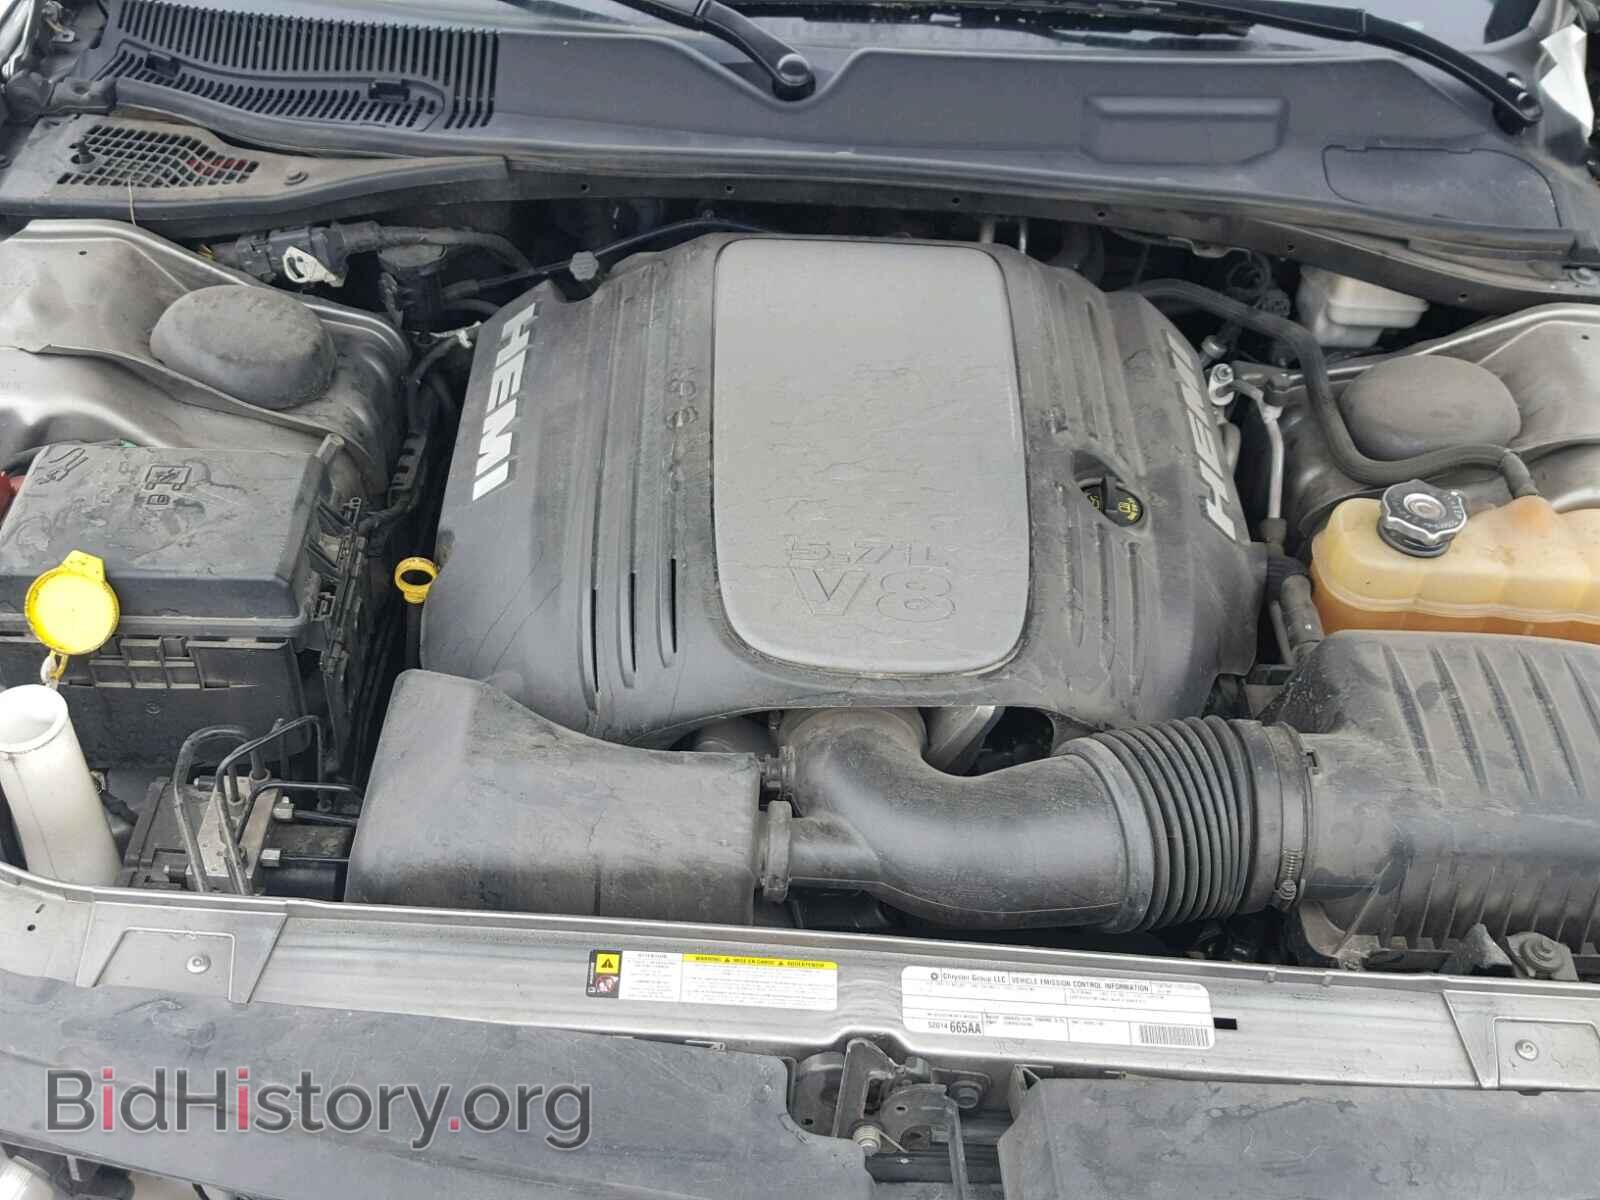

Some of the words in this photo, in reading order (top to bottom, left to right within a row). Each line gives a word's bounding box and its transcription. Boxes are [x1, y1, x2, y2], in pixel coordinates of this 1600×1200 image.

[472, 302, 536, 502] HEMI
[1166, 330, 1236, 541] HEMI
[789, 565, 957, 624] V8
[971, 974, 992, 984] Group
[993, 975, 1006, 984] LLC
[1011, 977, 1038, 986] VEHICLE
[1040, 979, 1071, 988] EMISSION
[1072, 981, 1102, 990] CONTROL
[1104, 982, 1149, 993] INFORMATION
[949, 1021, 982, 1034] 665AA
